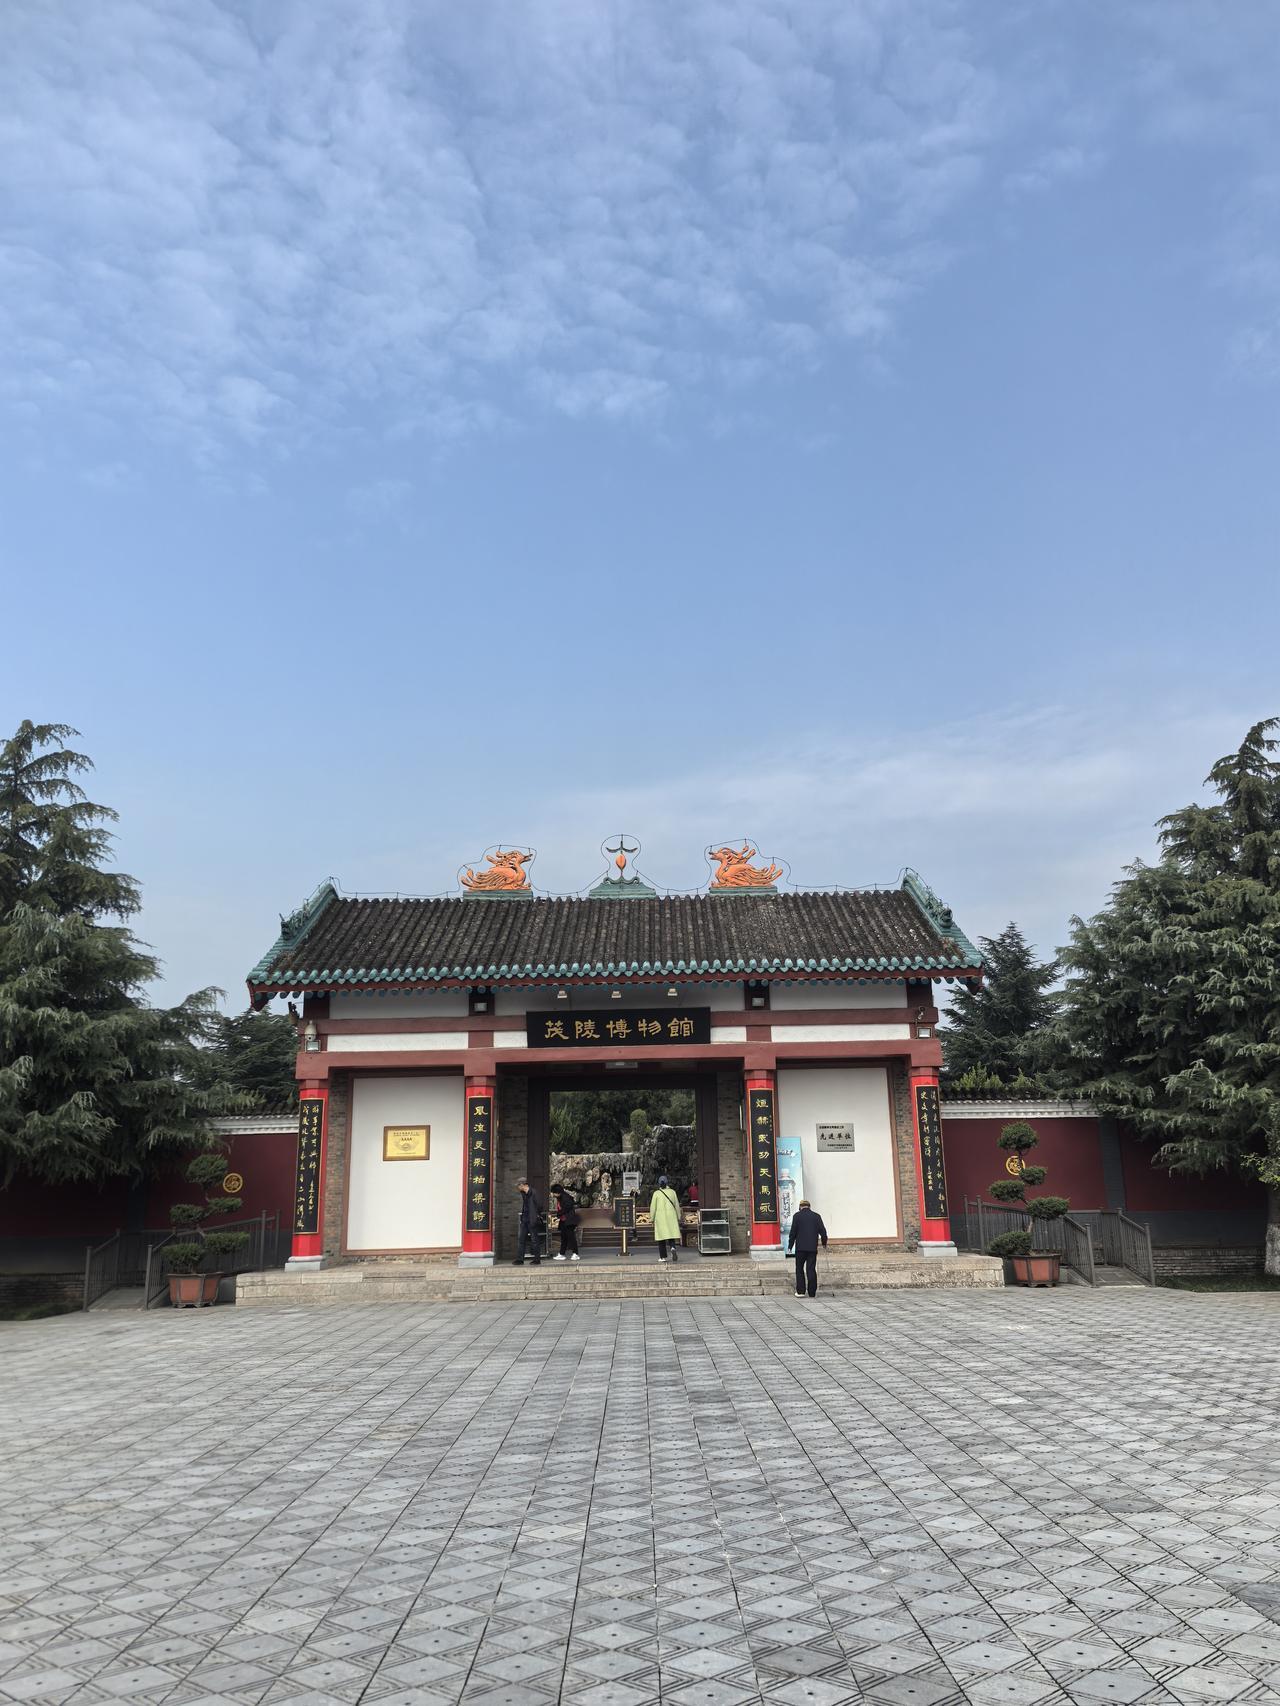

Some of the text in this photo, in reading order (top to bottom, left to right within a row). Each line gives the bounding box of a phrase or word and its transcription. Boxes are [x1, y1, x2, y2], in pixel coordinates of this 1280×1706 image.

[545, 1017, 694, 1040] 茂陵博物館
